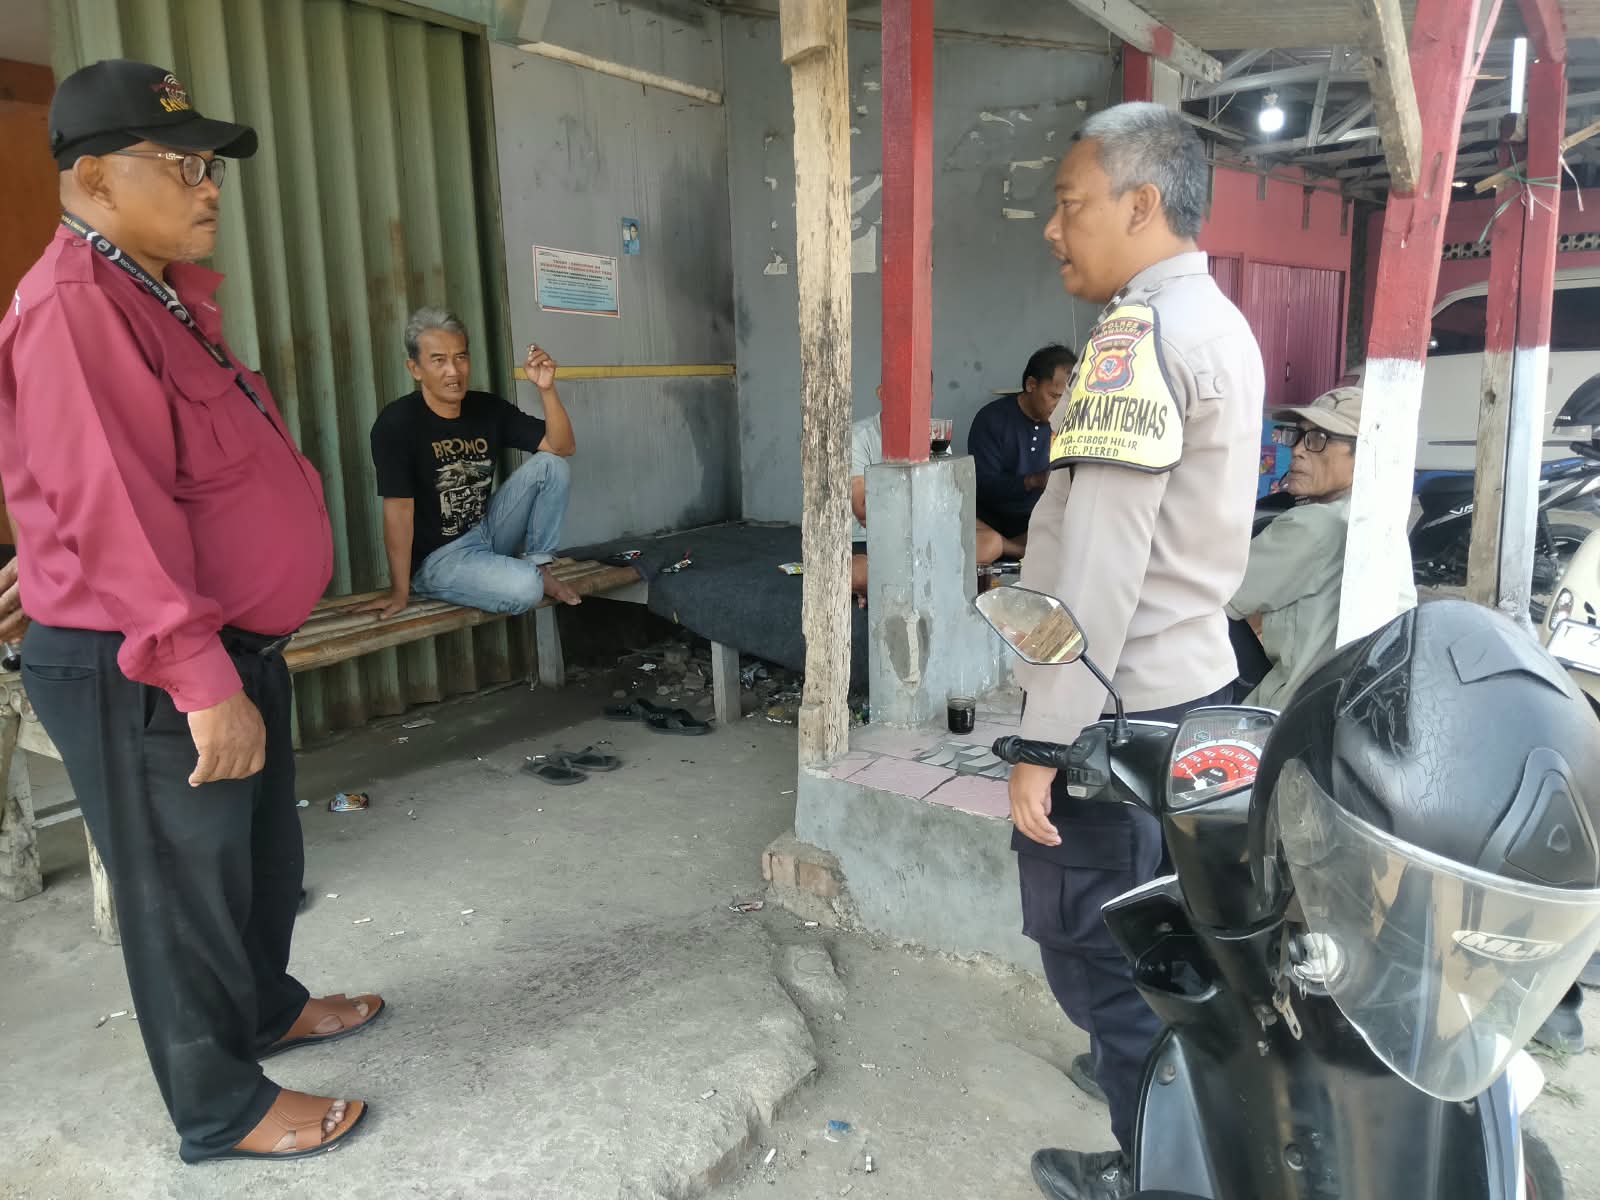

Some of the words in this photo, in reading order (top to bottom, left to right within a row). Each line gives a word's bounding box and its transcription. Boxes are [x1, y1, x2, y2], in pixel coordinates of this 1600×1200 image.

[431, 437, 488, 459] BROMO
[1077, 435, 1108, 445] CIBOGO
[1110, 438, 1138, 451] HILIR
[1082, 445, 1119, 457] PLERED
